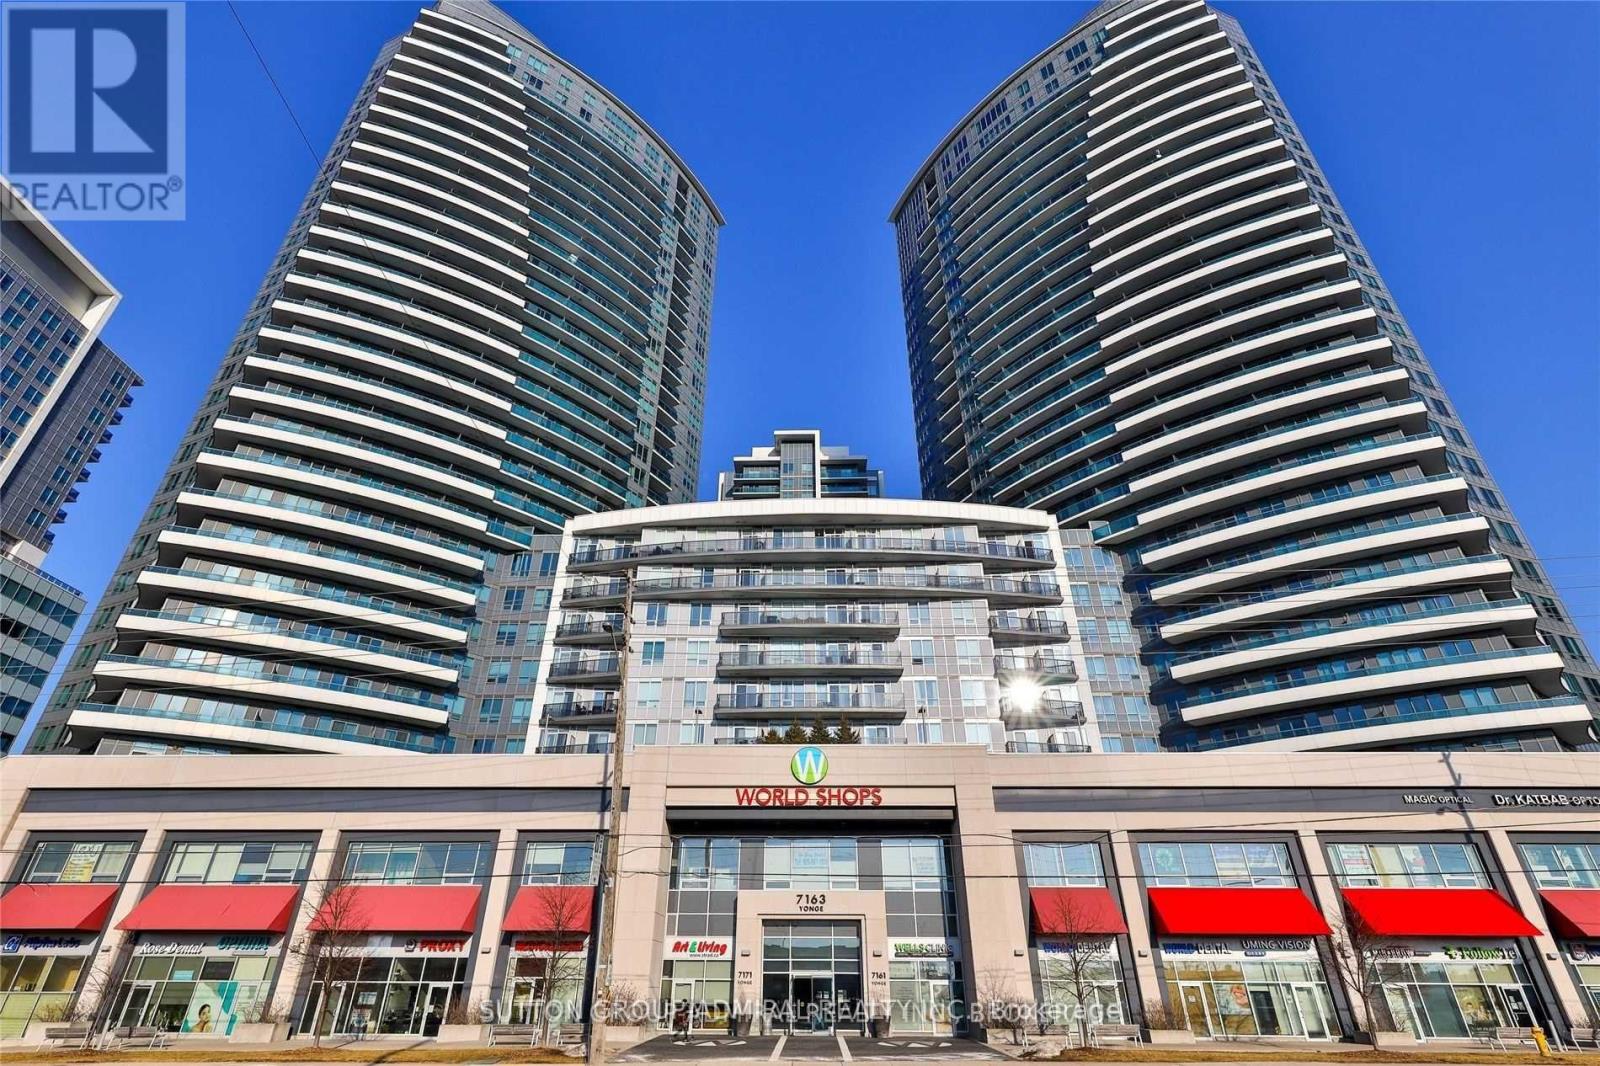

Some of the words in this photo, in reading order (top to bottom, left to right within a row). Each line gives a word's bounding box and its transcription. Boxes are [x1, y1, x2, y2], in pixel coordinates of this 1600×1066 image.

[735, 787, 809, 806] WORLD
[816, 787, 882, 807] SHOPS
[1403, 794, 1437, 804] MAGIC
[1438, 796, 1474, 804] OPTICAL
[1517, 794, 1569, 807] KATBAB
[796, 894, 826, 905] 7163
[140, 943, 165, 954] Rose
[166, 942, 203, 954] Dental
[672, 941, 689, 952] Art
[697, 941, 728, 956] Living
[1197, 943, 1232, 954] DENTAL
[1277, 940, 1311, 950] VISION
[737, 971, 752, 979] 7171
